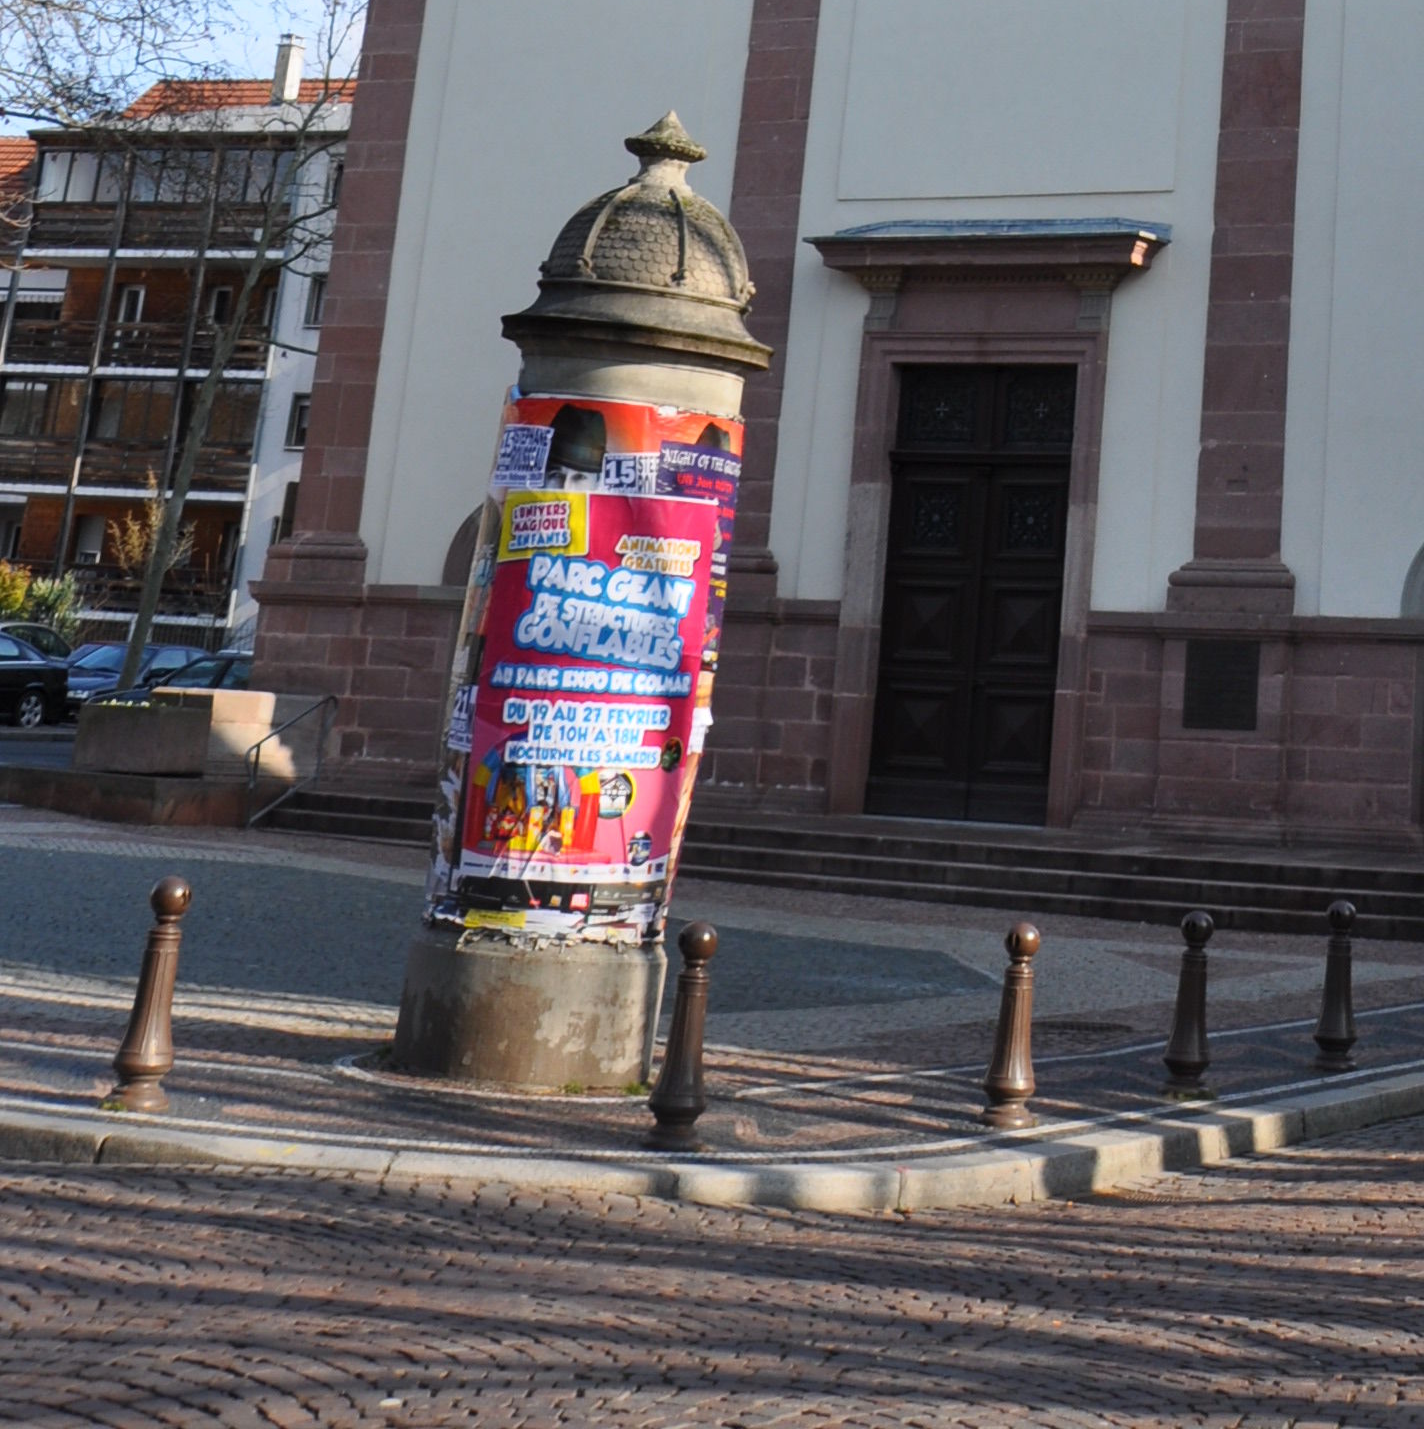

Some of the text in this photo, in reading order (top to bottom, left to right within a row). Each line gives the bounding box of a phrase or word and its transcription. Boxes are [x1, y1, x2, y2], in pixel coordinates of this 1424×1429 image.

[605, 460, 635, 485] 15
[514, 518, 566, 532] MAGIQUE
[517, 531, 567, 546] ENFANTS
[620, 539, 698, 556] ANIMATIONS
[625, 556, 691, 574] GRATUITES
[530, 556, 605, 597] PARC
[607, 570, 694, 614] GEANT
[534, 593, 677, 639] DE STRUCTURES
[518, 613, 681, 670] GONFLABLES
[493, 666, 691, 695] AU PARC EXPO DE COLMAR
[507, 702, 669, 726] DU 19 AU 27 FEVRIER
[533, 724, 551, 741] DE
[559, 726, 588, 742] 10H
[614, 728, 640, 745] 18H
[508, 745, 658, 765] NOCTURNE LES SAMEDIS
